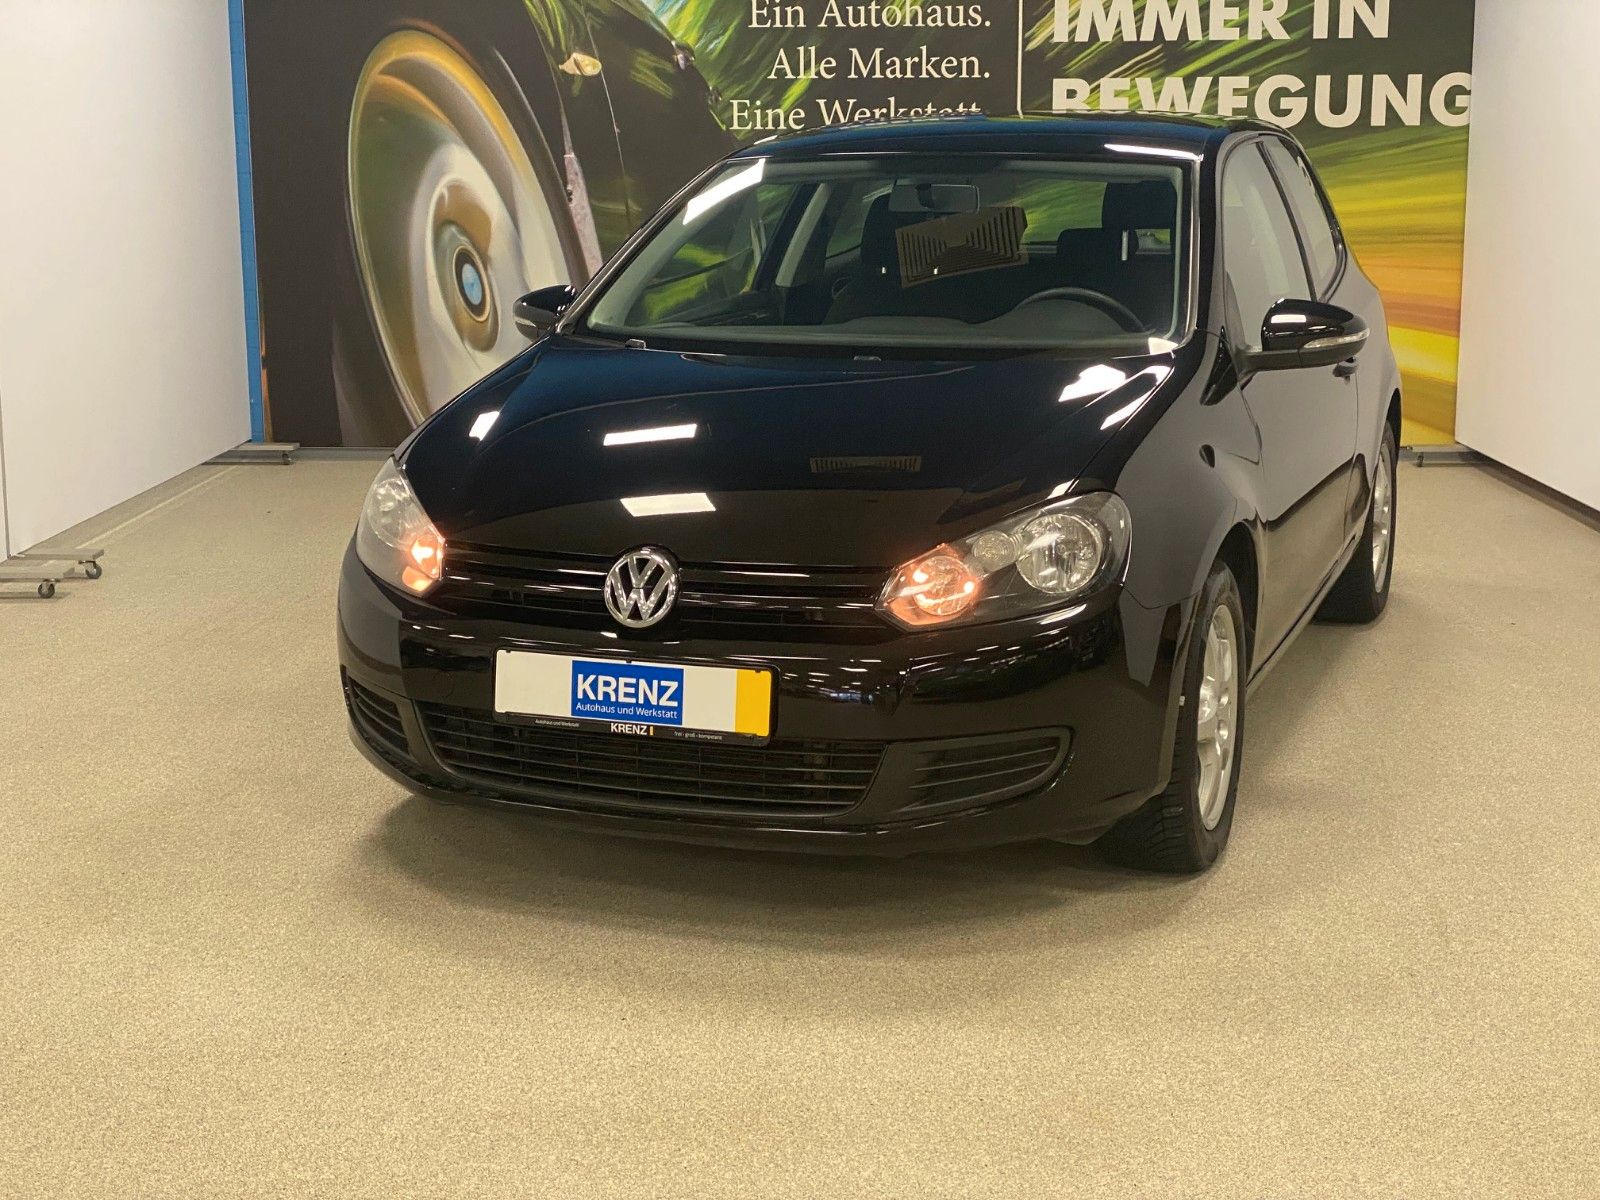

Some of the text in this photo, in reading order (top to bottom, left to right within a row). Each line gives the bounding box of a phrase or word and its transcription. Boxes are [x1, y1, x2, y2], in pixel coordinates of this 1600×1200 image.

[748, 0, 991, 28] Ein Autohaus.
[1053, 0, 1389, 43] IMMER IN
[767, 46, 990, 79] Alle Marken.
[729, 98, 805, 130] Eine
[1052, 72, 1472, 129] BEWEGUNG
[577, 673, 679, 707] KRENZ
[576, 702, 678, 719] Autohaus und Werkstatt
[610, 722, 648, 736] KRENZ
